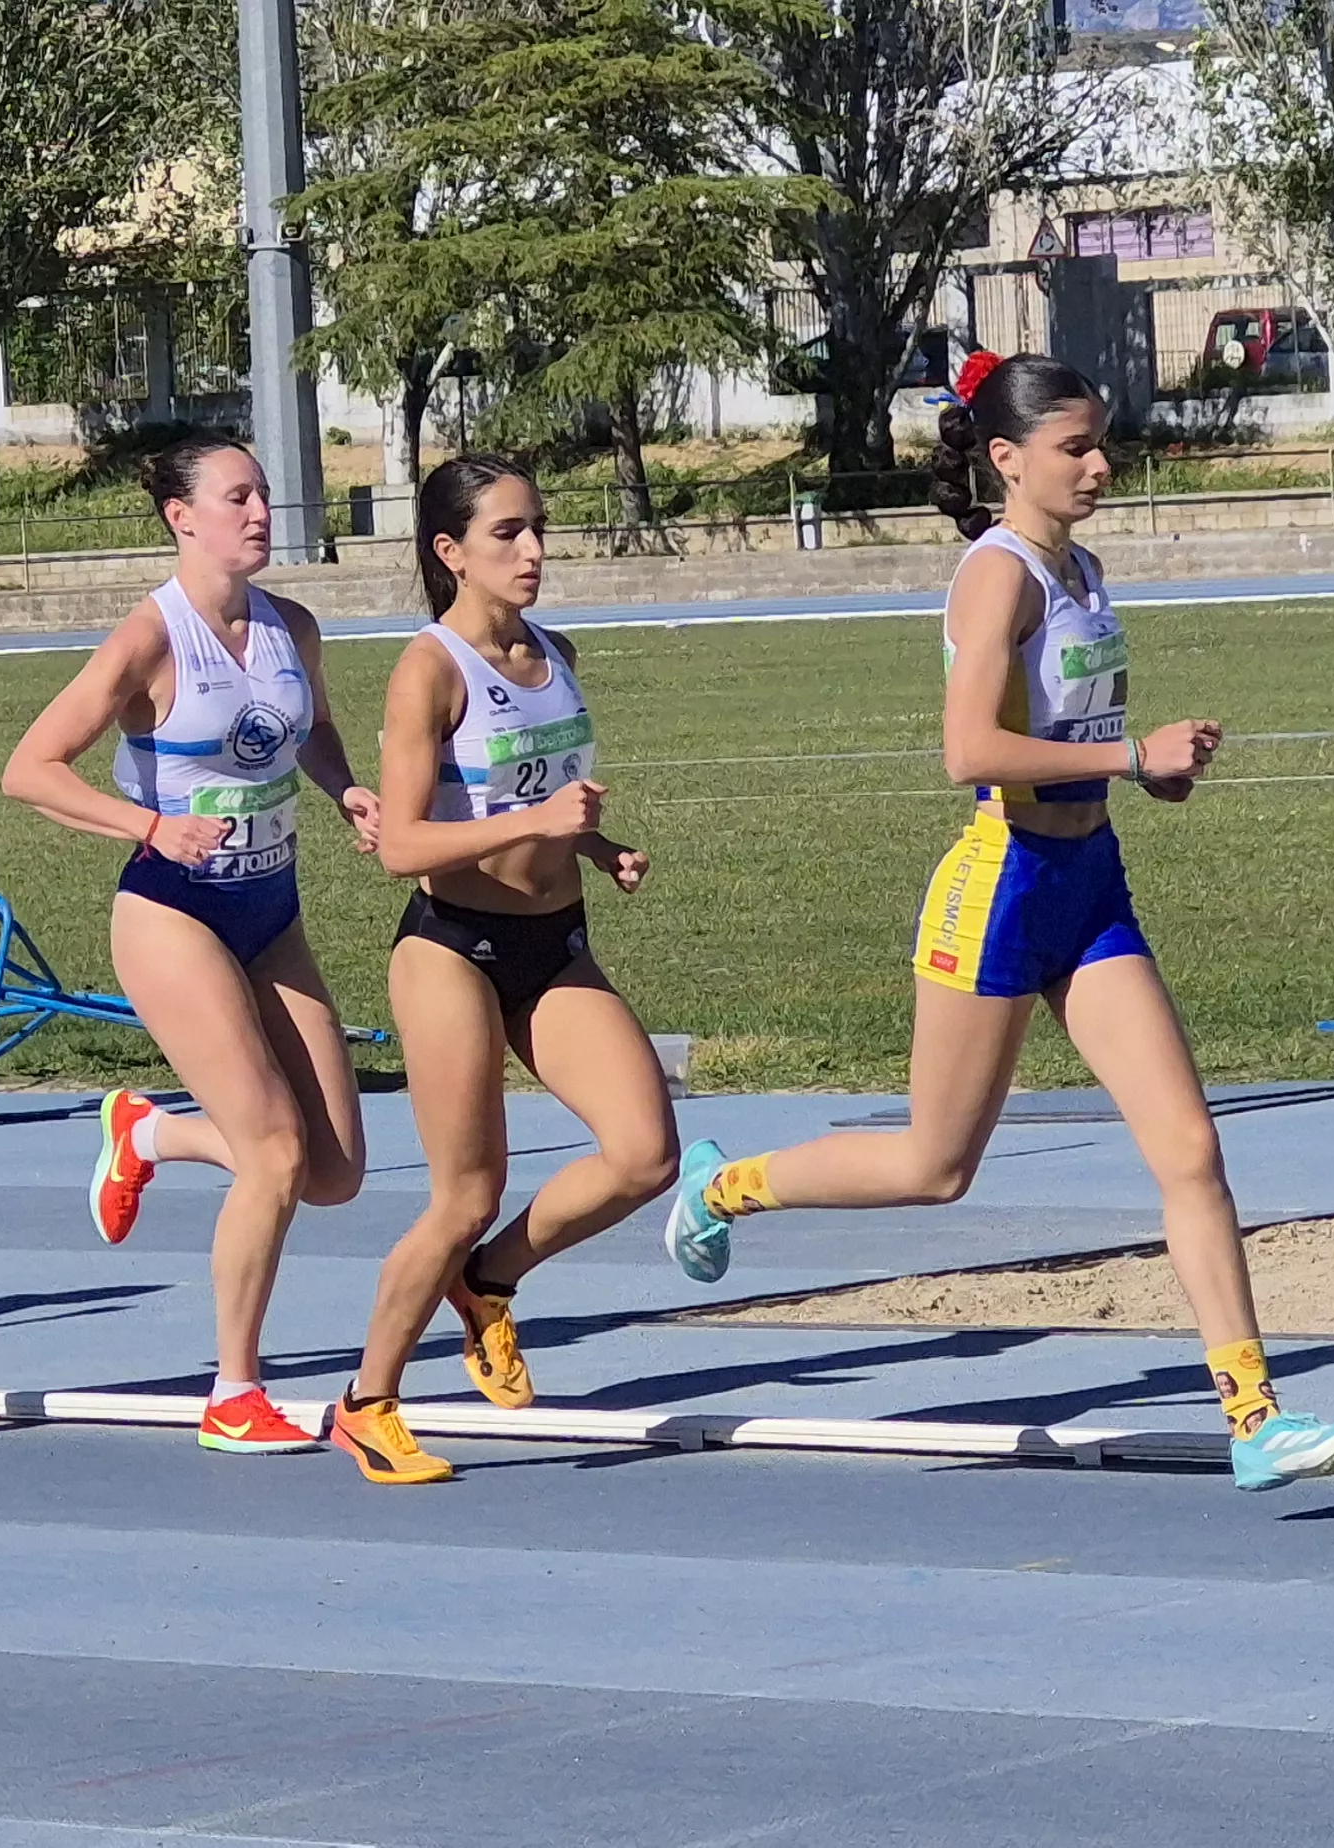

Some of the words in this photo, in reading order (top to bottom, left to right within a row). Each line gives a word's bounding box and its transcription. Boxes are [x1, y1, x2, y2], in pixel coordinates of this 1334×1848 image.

[515, 758, 548, 797] 22
[220, 814, 254, 851] 21
[940, 836, 983, 936] ATLETISMO
